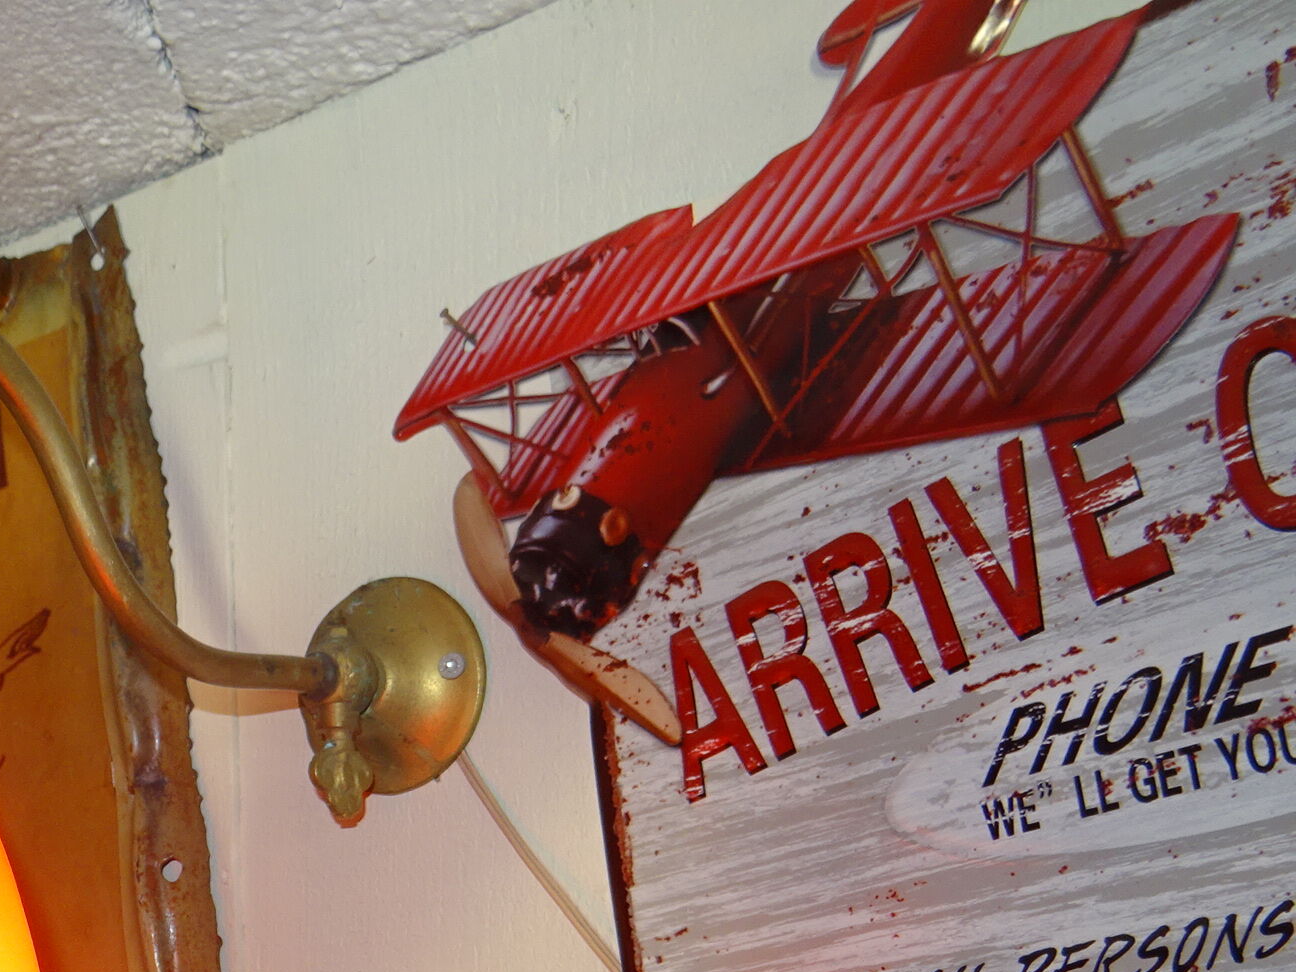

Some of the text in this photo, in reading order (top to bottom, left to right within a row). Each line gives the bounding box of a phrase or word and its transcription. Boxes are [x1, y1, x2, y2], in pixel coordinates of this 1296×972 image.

[668, 400, 1175, 804] ARRIVE
[982, 625, 1294, 787] PHONE
[1129, 743, 1203, 804] GET
